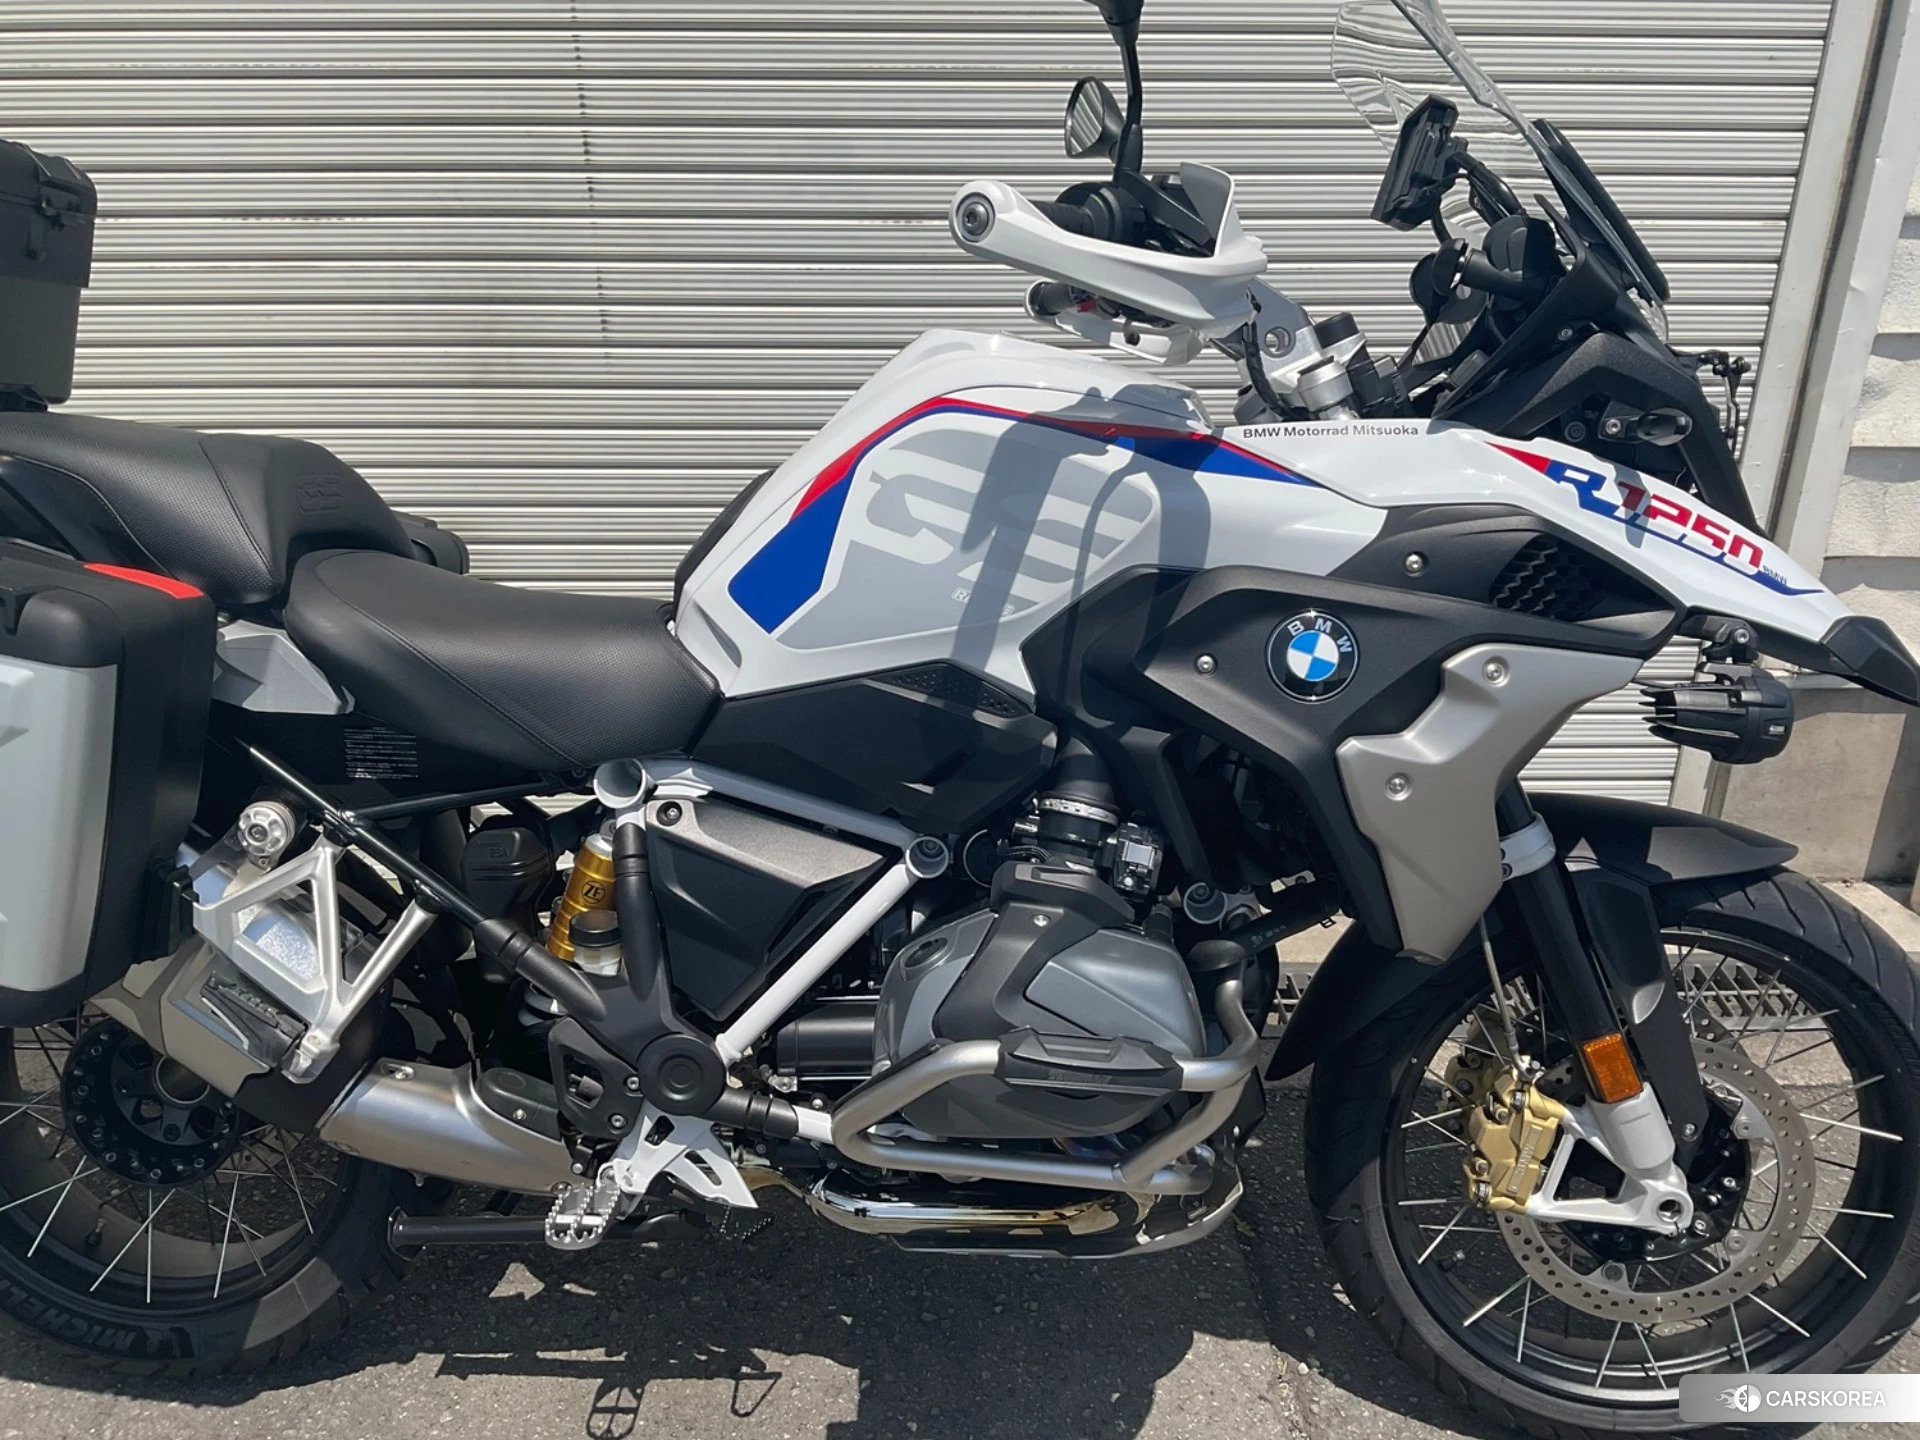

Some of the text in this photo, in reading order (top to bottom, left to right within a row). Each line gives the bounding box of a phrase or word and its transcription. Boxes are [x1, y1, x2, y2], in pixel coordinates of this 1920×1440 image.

[1243, 425, 1418, 439] BMW Motorrad Mitsuoka
[1287, 618, 1353, 653] BMW
[583, 885, 601, 898] ZF
